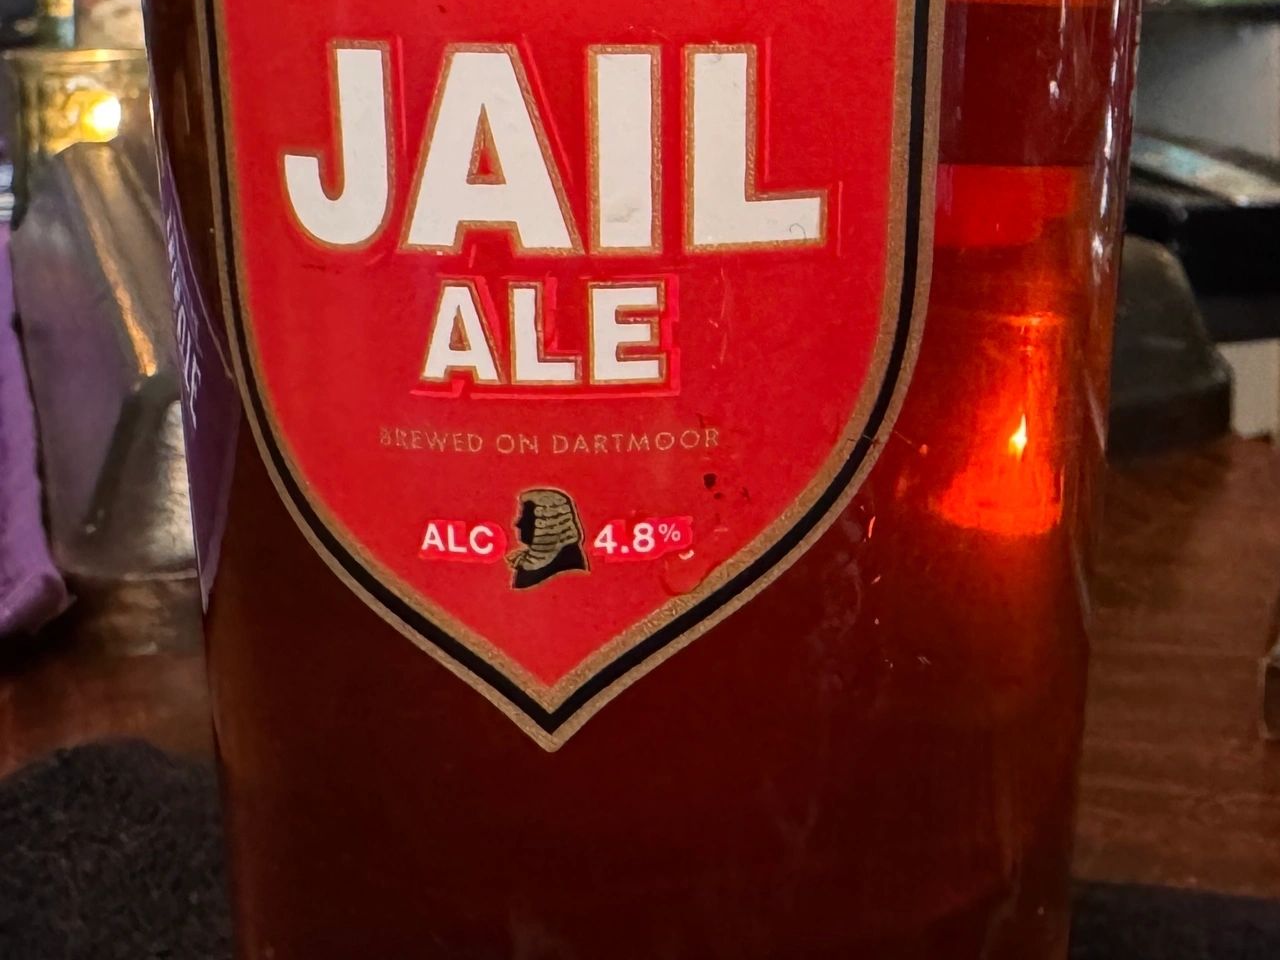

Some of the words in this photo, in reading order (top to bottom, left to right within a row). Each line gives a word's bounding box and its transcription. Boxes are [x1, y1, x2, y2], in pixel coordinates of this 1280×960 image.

[282, 40, 828, 255] JAIL
[419, 279, 666, 385] ALE
[380, 426, 484, 453] BREWED
[496, 433, 540, 455] ON
[552, 427, 720, 455] DARTMOOR
[420, 522, 495, 556] ALC
[593, 522, 682, 555] 4.8%
